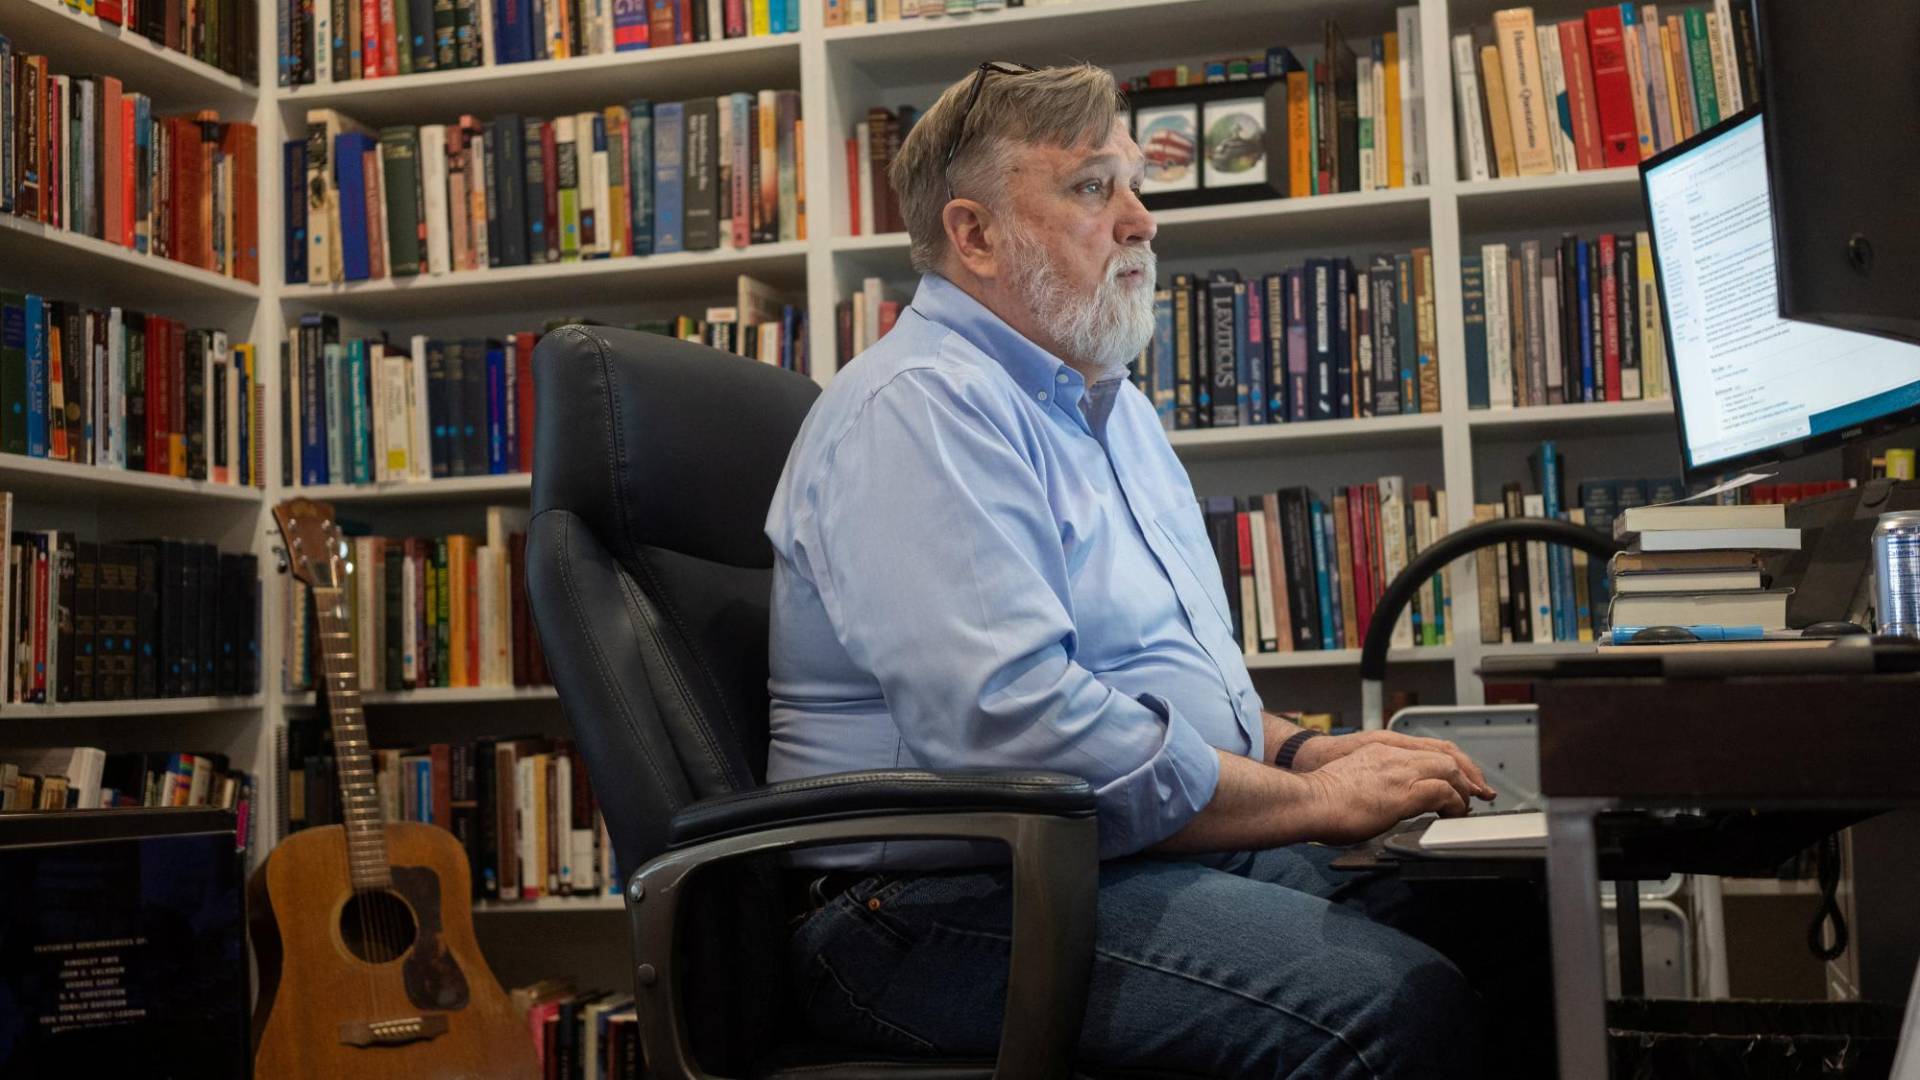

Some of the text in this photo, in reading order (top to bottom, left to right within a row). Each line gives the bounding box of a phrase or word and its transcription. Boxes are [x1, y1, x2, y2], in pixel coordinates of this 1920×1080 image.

[1512, 29, 1537, 149] Humorous Quotations
[688, 133, 697, 177] Testament
[698, 114, 709, 164] Introduction
[1380, 279, 1394, 324] Sanctions
[1212, 296, 1235, 388] LEVITICUS
[1382, 336, 1396, 381] Dominion
[79, 988, 126, 999] CHESTERTON
